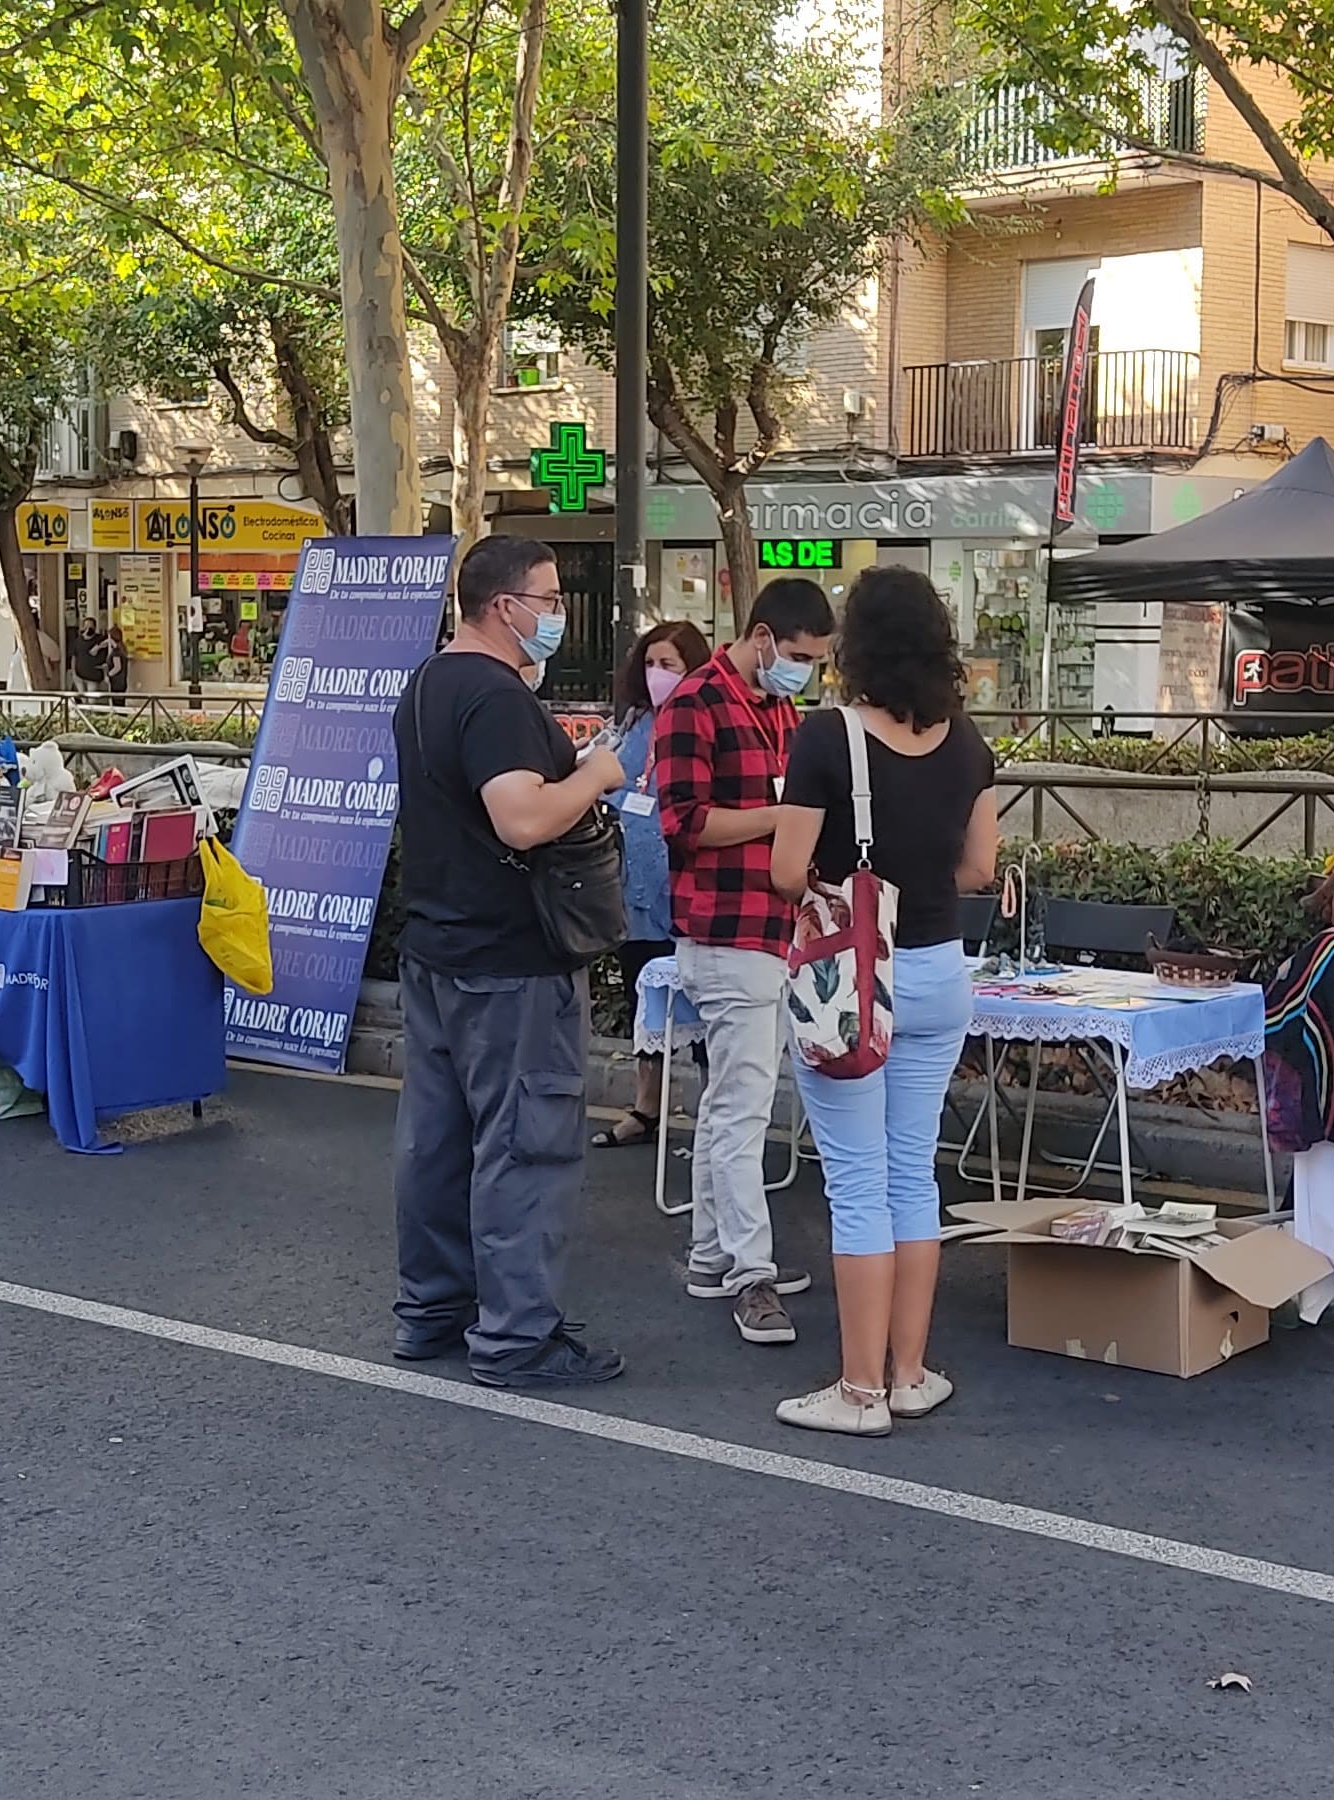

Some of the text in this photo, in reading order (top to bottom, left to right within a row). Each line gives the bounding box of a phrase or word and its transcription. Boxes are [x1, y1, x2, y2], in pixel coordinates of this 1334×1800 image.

[243, 516, 319, 527] Electrodomésticos
[262, 529, 296, 541] Cocinas
[798, 541, 834, 566] DE
[333, 556, 388, 585] MADRE
[391, 555, 448, 590] CORAJE
[322, 615, 437, 650] MADRE CORAJE
[309, 667, 414, 697] MADRE CORA
[298, 724, 356, 752] MADRE
[284, 776, 399, 817] MADRE CORAJE
[271, 835, 386, 877] MADRE CORAJE
[319, 893, 373, 931] CORAJE
[230, 998, 347, 1047] MADRE CORAJE
